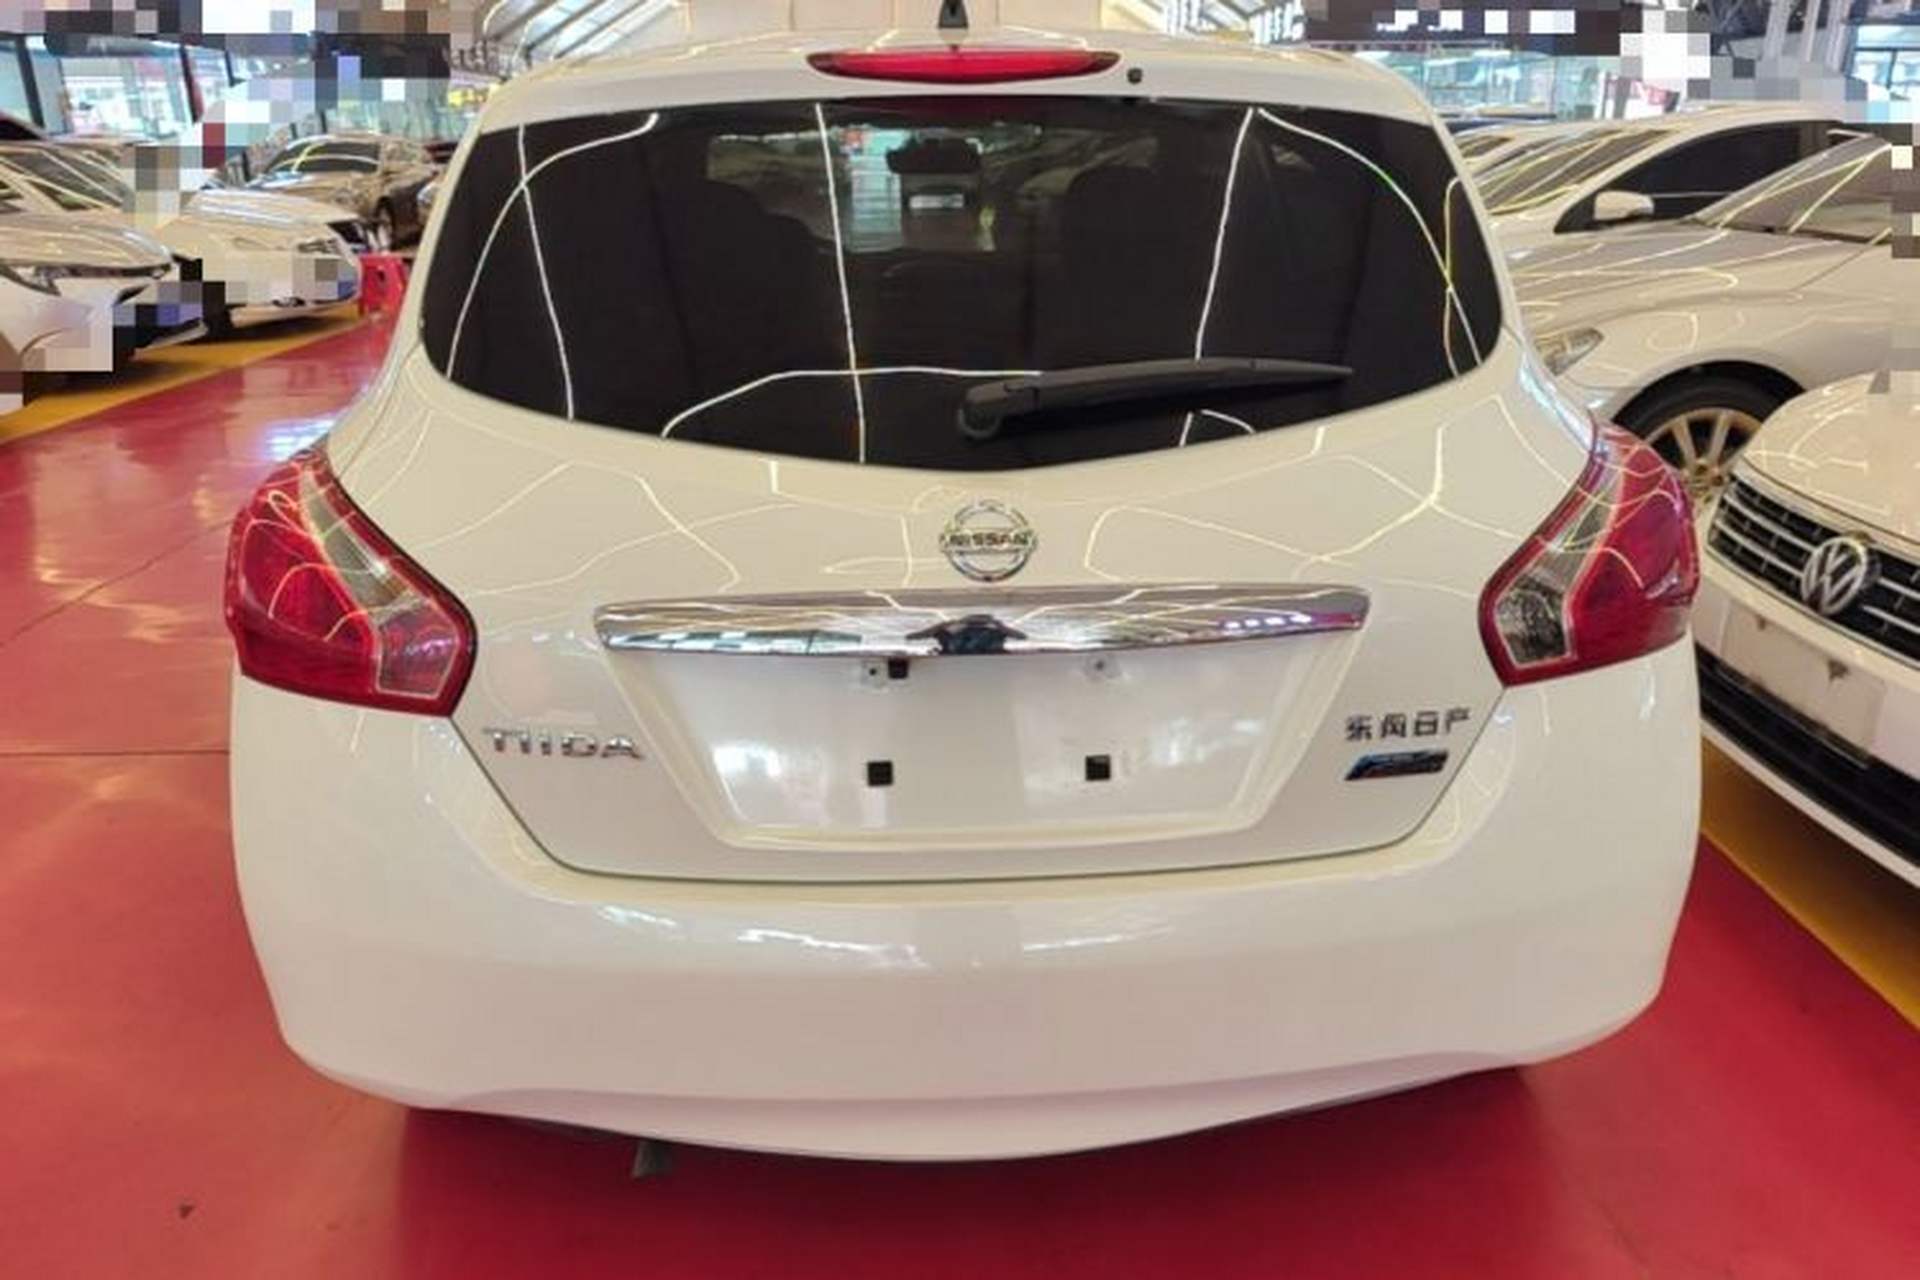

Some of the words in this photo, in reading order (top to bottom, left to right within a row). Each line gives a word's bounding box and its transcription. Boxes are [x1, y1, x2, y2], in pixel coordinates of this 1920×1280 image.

[946, 530, 1033, 549] NISSAN
[1346, 706, 1470, 742] 东风日产
[482, 726, 645, 761] TIIDA
